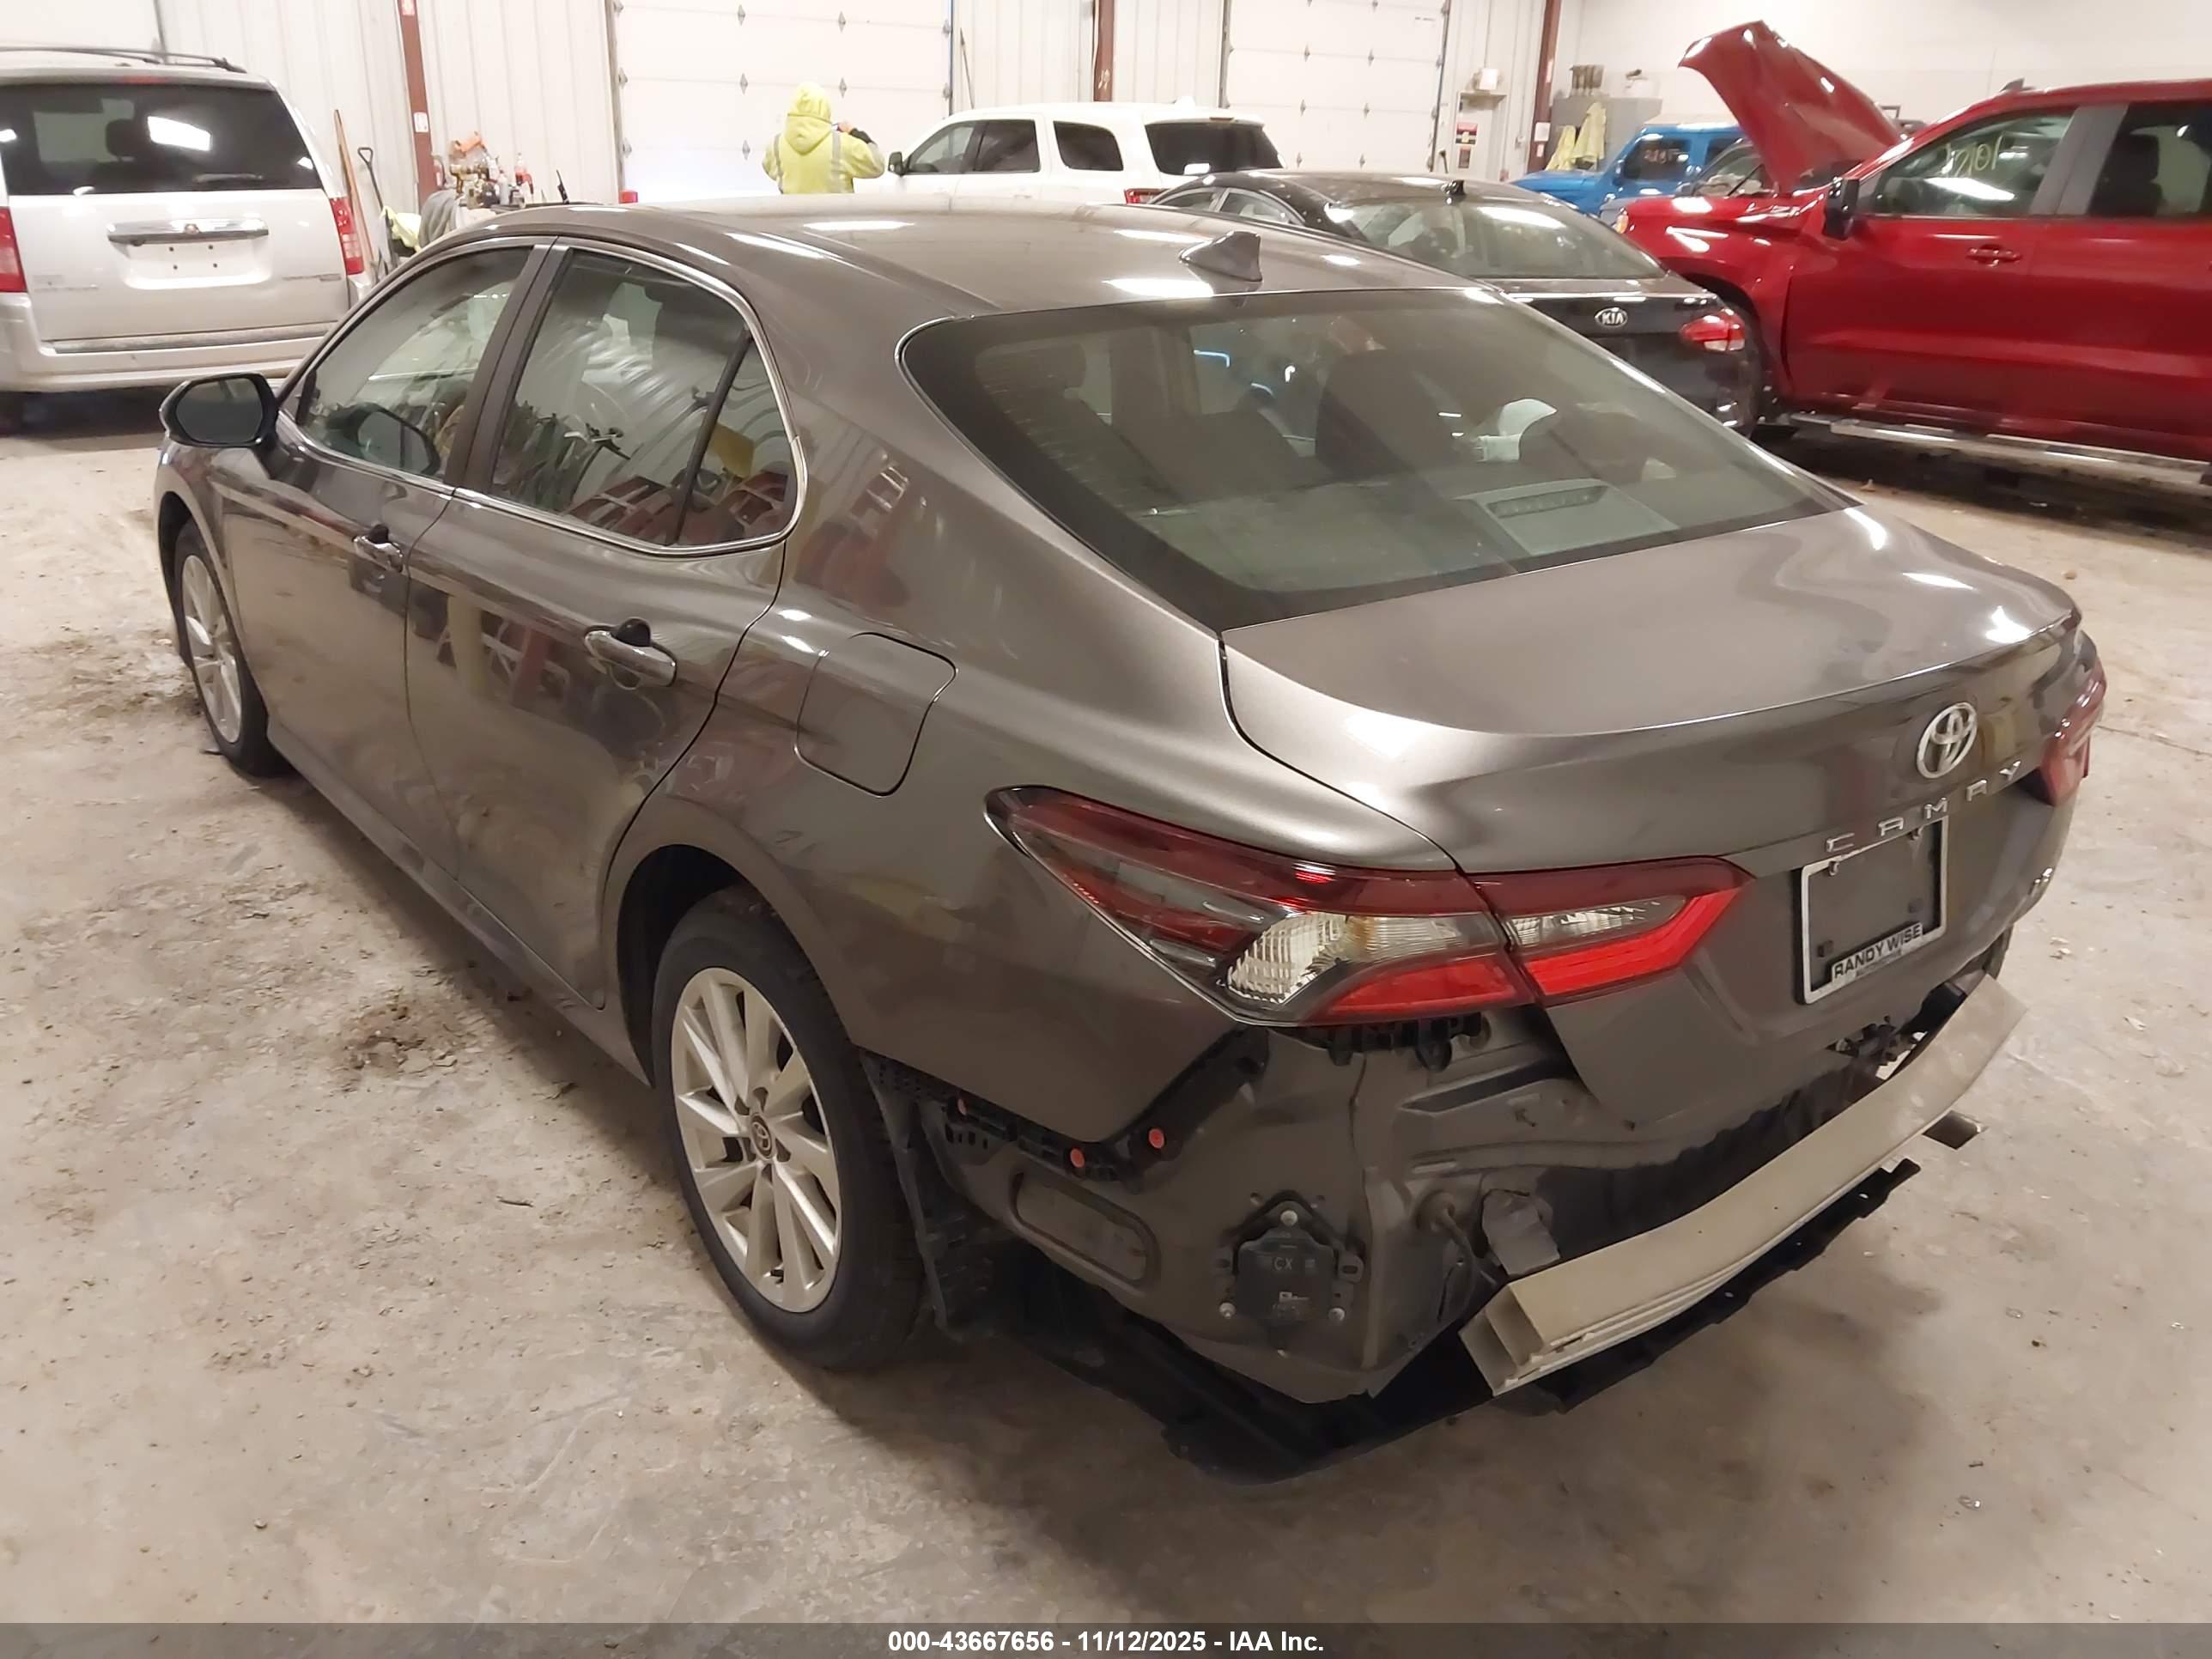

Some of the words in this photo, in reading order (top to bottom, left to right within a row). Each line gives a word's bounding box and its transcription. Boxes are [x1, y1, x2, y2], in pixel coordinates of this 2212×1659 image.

[1826, 761, 2021, 853] CAMRY
[1833, 941, 1884, 979] RANDY
[1887, 923, 1922, 952] WISE
